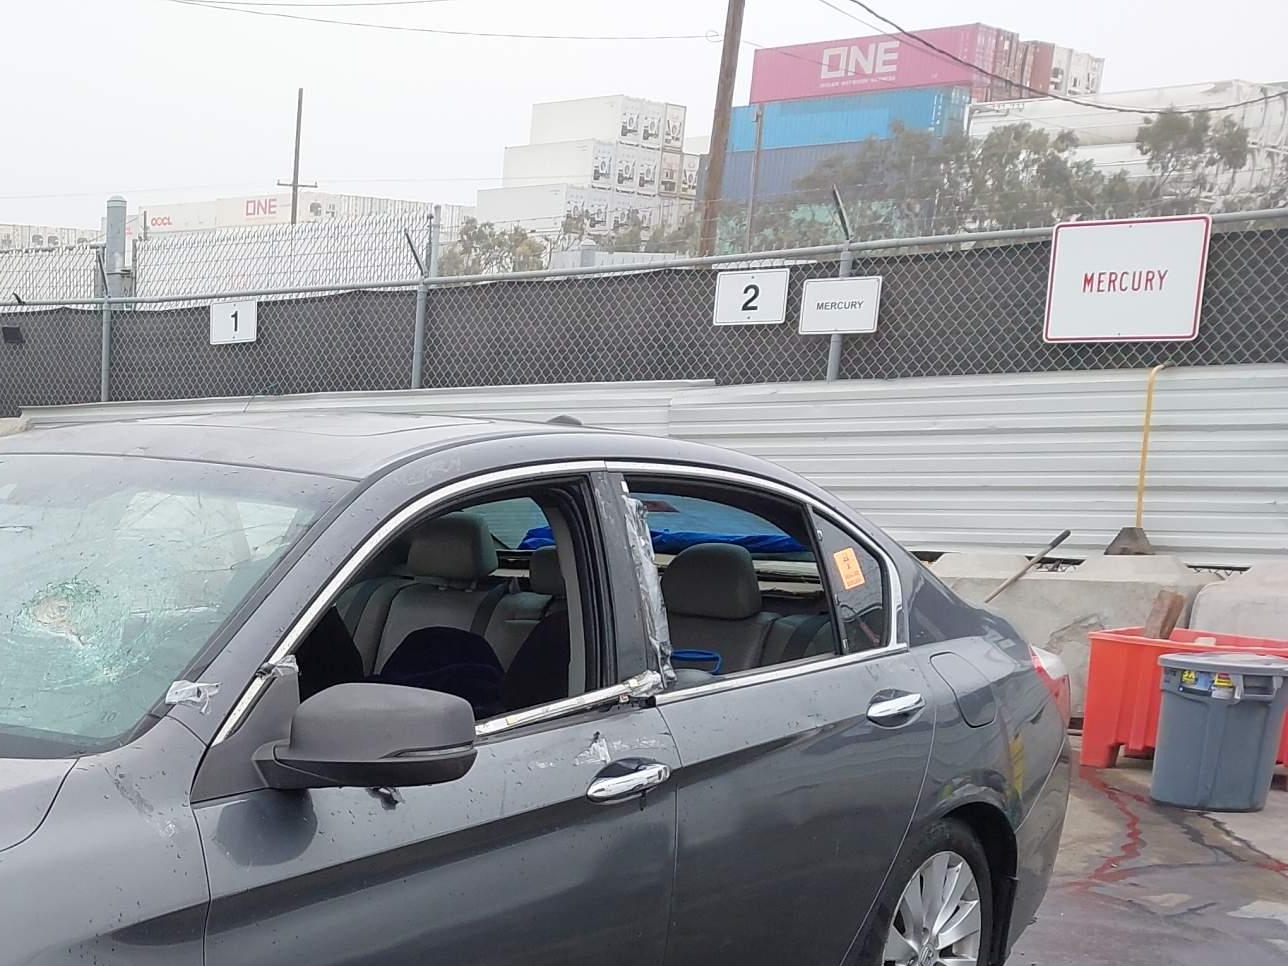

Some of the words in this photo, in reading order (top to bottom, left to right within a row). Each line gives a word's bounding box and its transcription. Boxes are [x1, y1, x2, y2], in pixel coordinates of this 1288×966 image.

[820, 40, 900, 79] ONE
[245, 198, 278, 217] ONE
[1082, 268, 1169, 294] MERCURY
[741, 284, 760, 312] 2
[815, 299, 865, 312] MERCURY
[230, 310, 239, 332] 1
